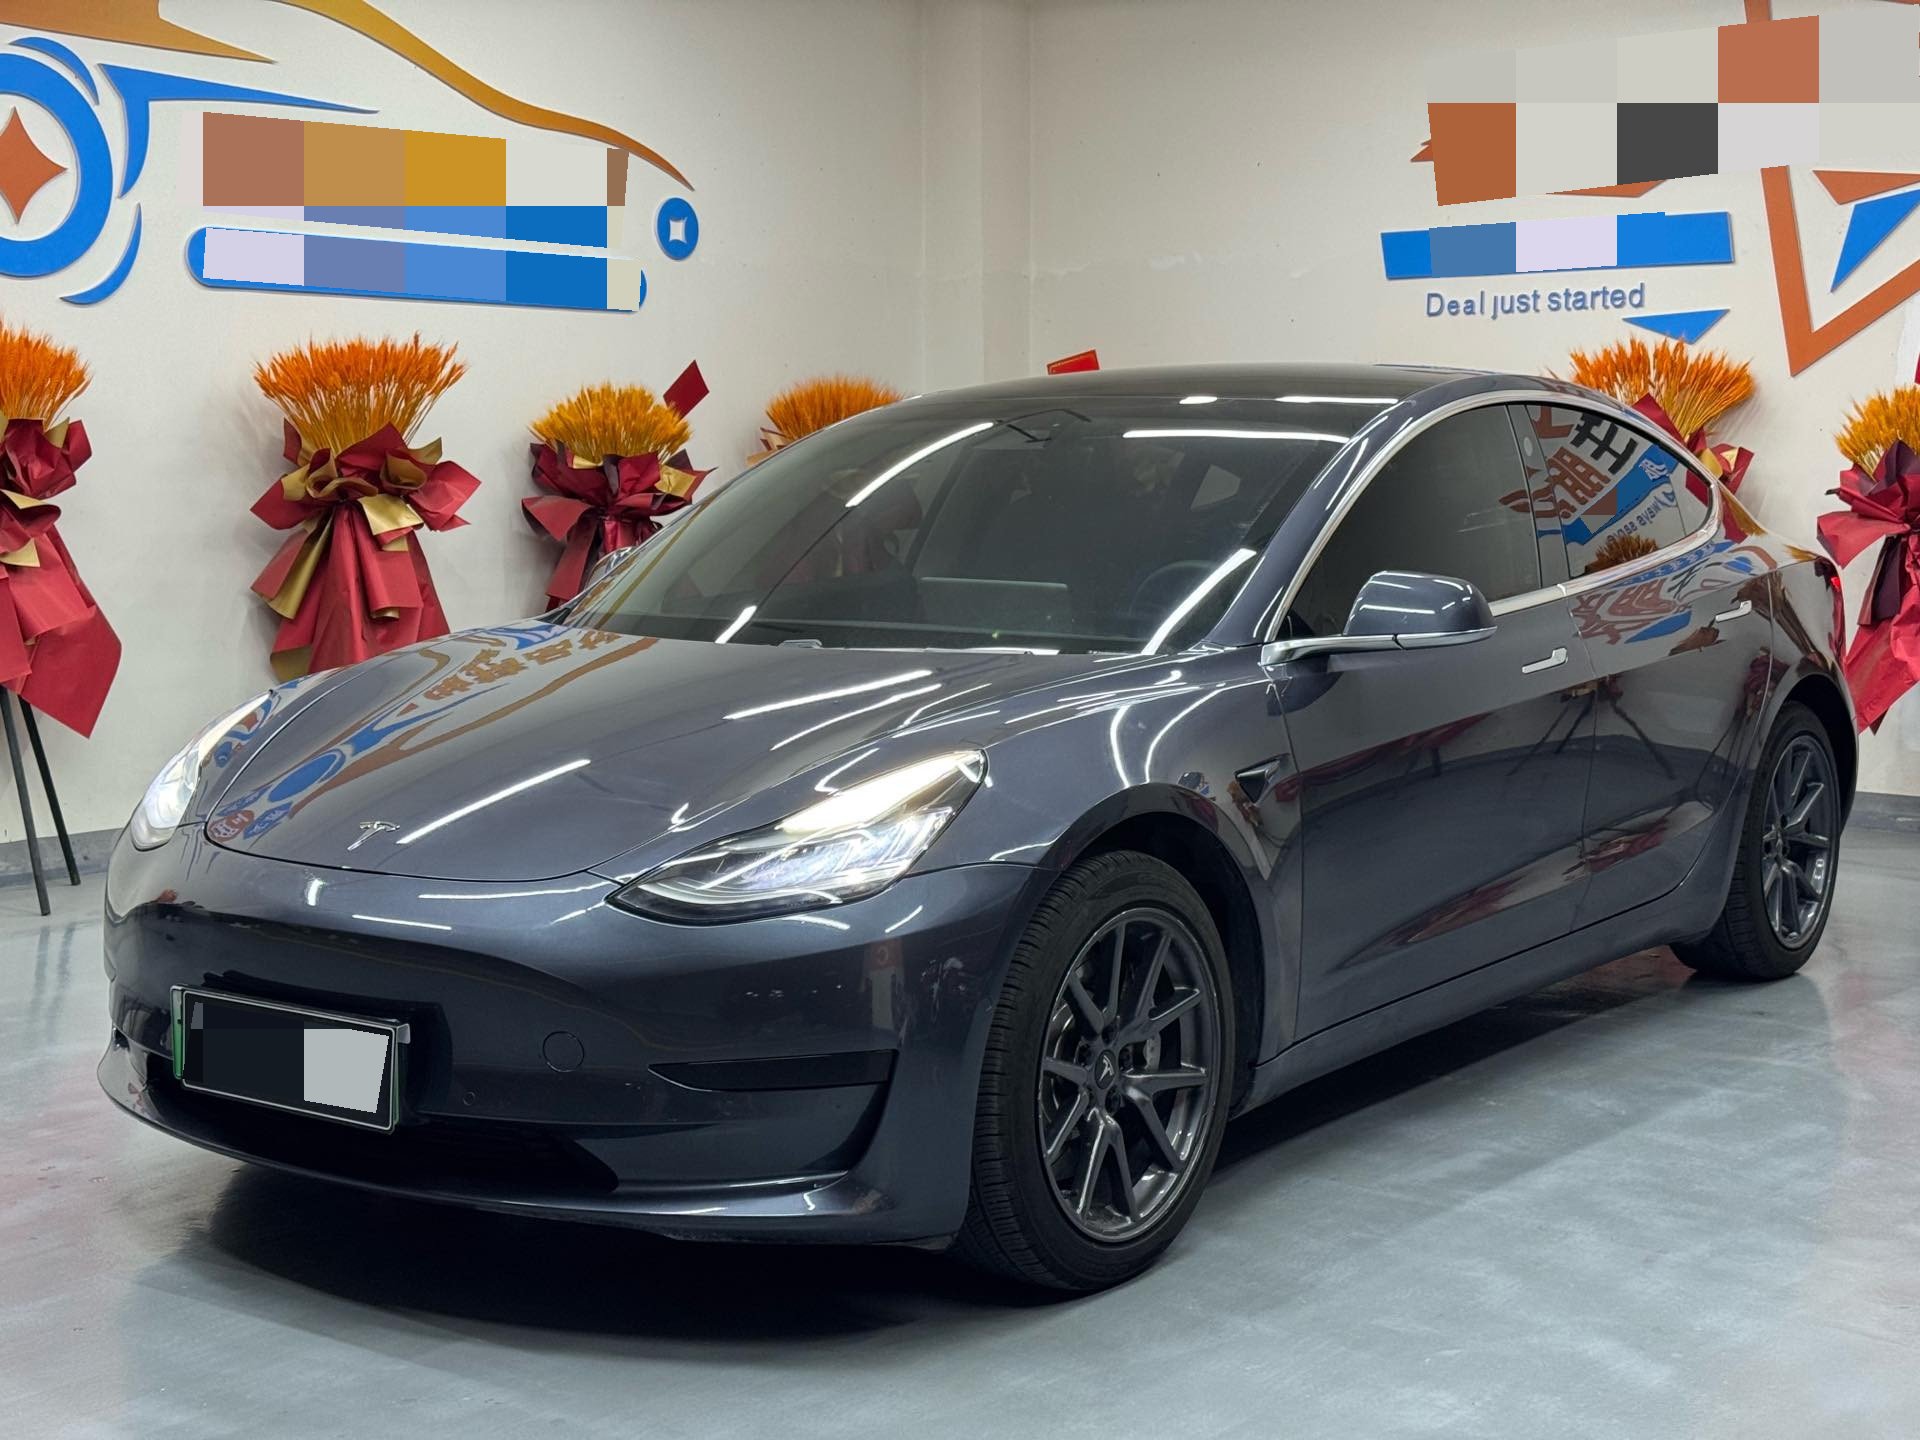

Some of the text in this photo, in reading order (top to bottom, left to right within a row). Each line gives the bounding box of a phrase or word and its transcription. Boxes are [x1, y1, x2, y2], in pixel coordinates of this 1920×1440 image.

[1426, 282, 1645, 320] Deal just started
